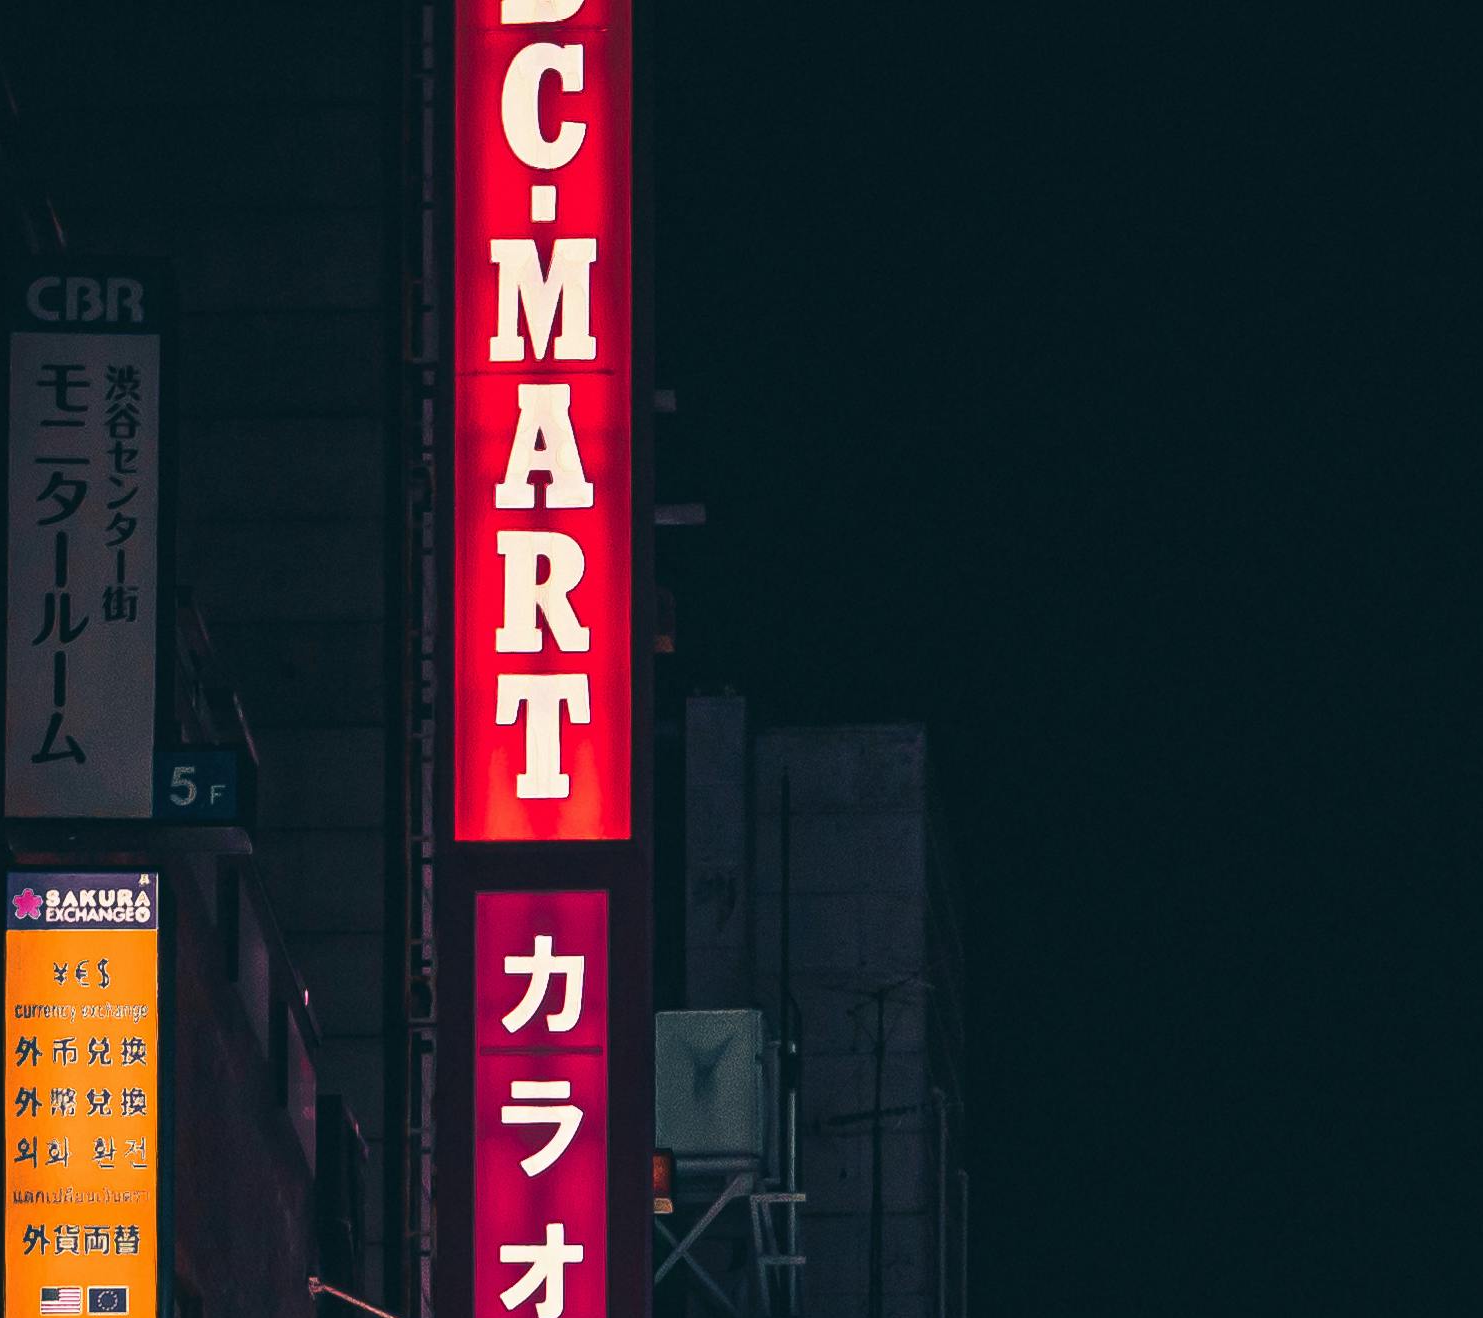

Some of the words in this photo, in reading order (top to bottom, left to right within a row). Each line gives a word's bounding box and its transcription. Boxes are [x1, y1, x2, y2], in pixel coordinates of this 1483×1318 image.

[25, 276, 145, 323] CBR
[488, 0, 598, 801] C-MART
[32, 363, 93, 766] モニタールーム
[101, 363, 142, 624] 渋谷センター街
[45, 889, 151, 909] SAKURA
[22, 1223, 142, 1258] 外貨両替
